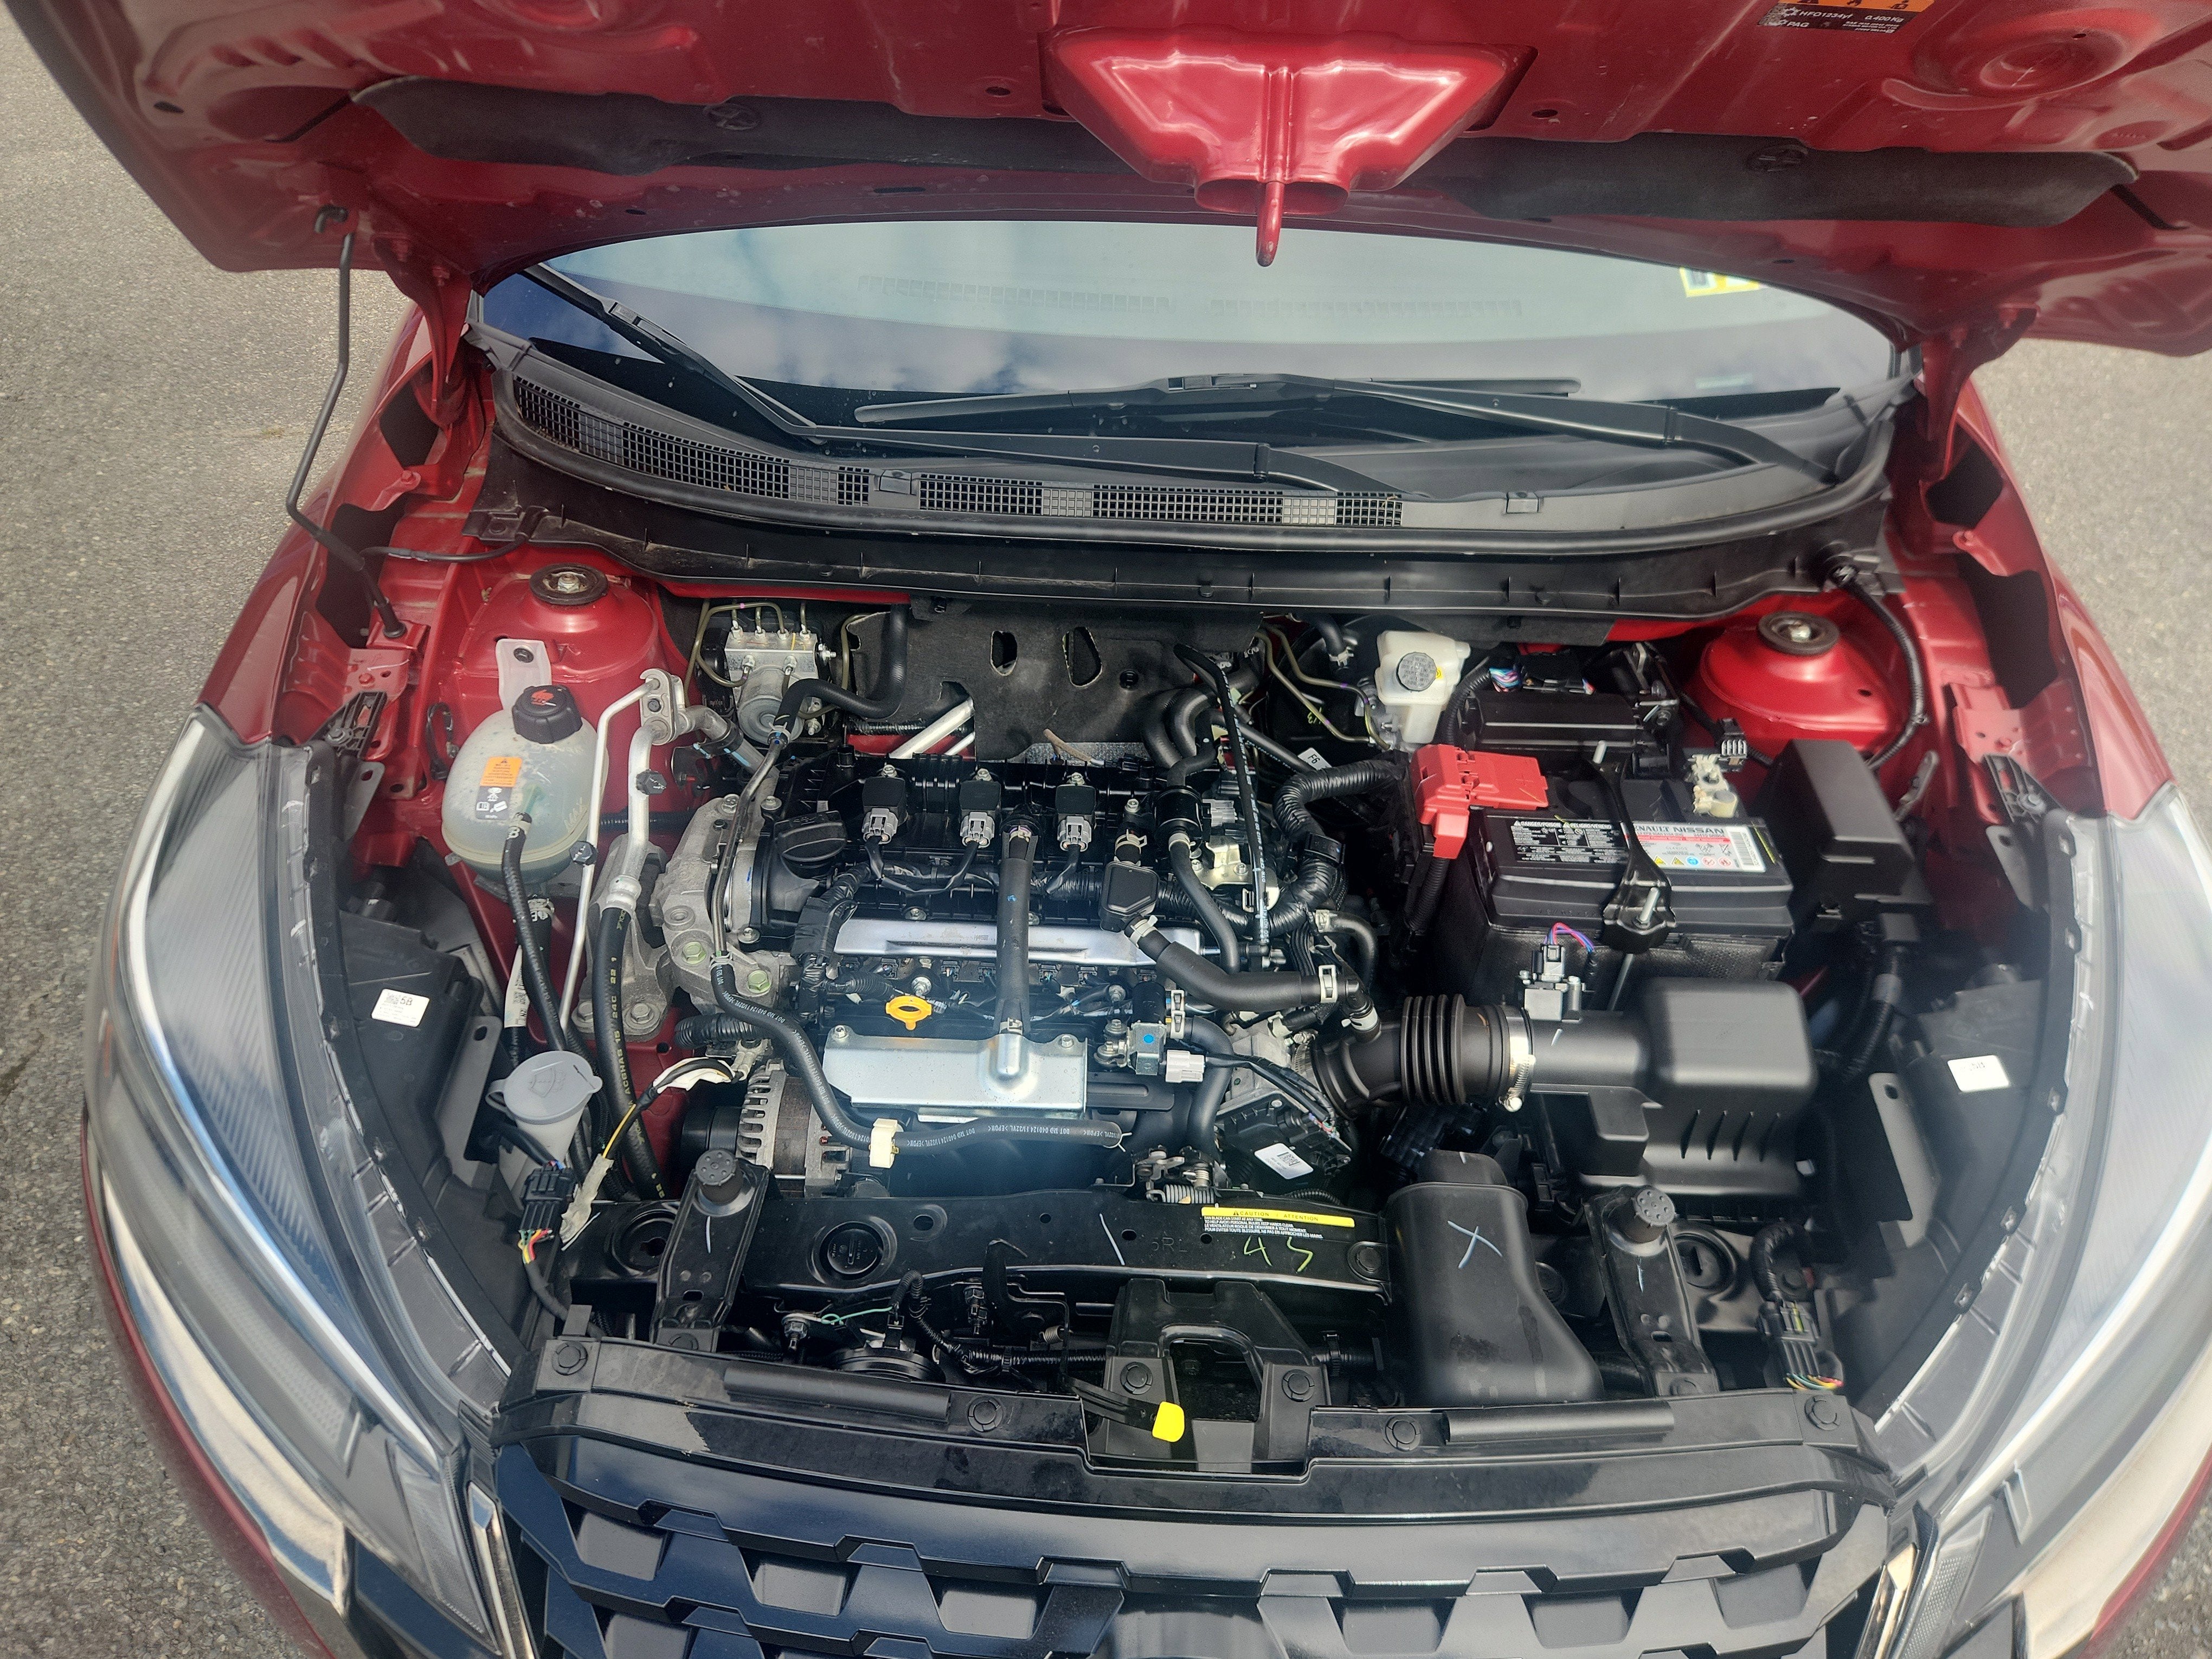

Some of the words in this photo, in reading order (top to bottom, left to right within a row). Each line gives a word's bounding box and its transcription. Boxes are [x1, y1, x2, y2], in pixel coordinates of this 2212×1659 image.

[1308, 754, 1320, 764] F6
[750, 1005, 767, 1016] 040124
[811, 1067, 822, 1086] 040124
[941, 1134, 956, 1142] 040124
[1283, 1213, 1319, 1221] ATTENTION
